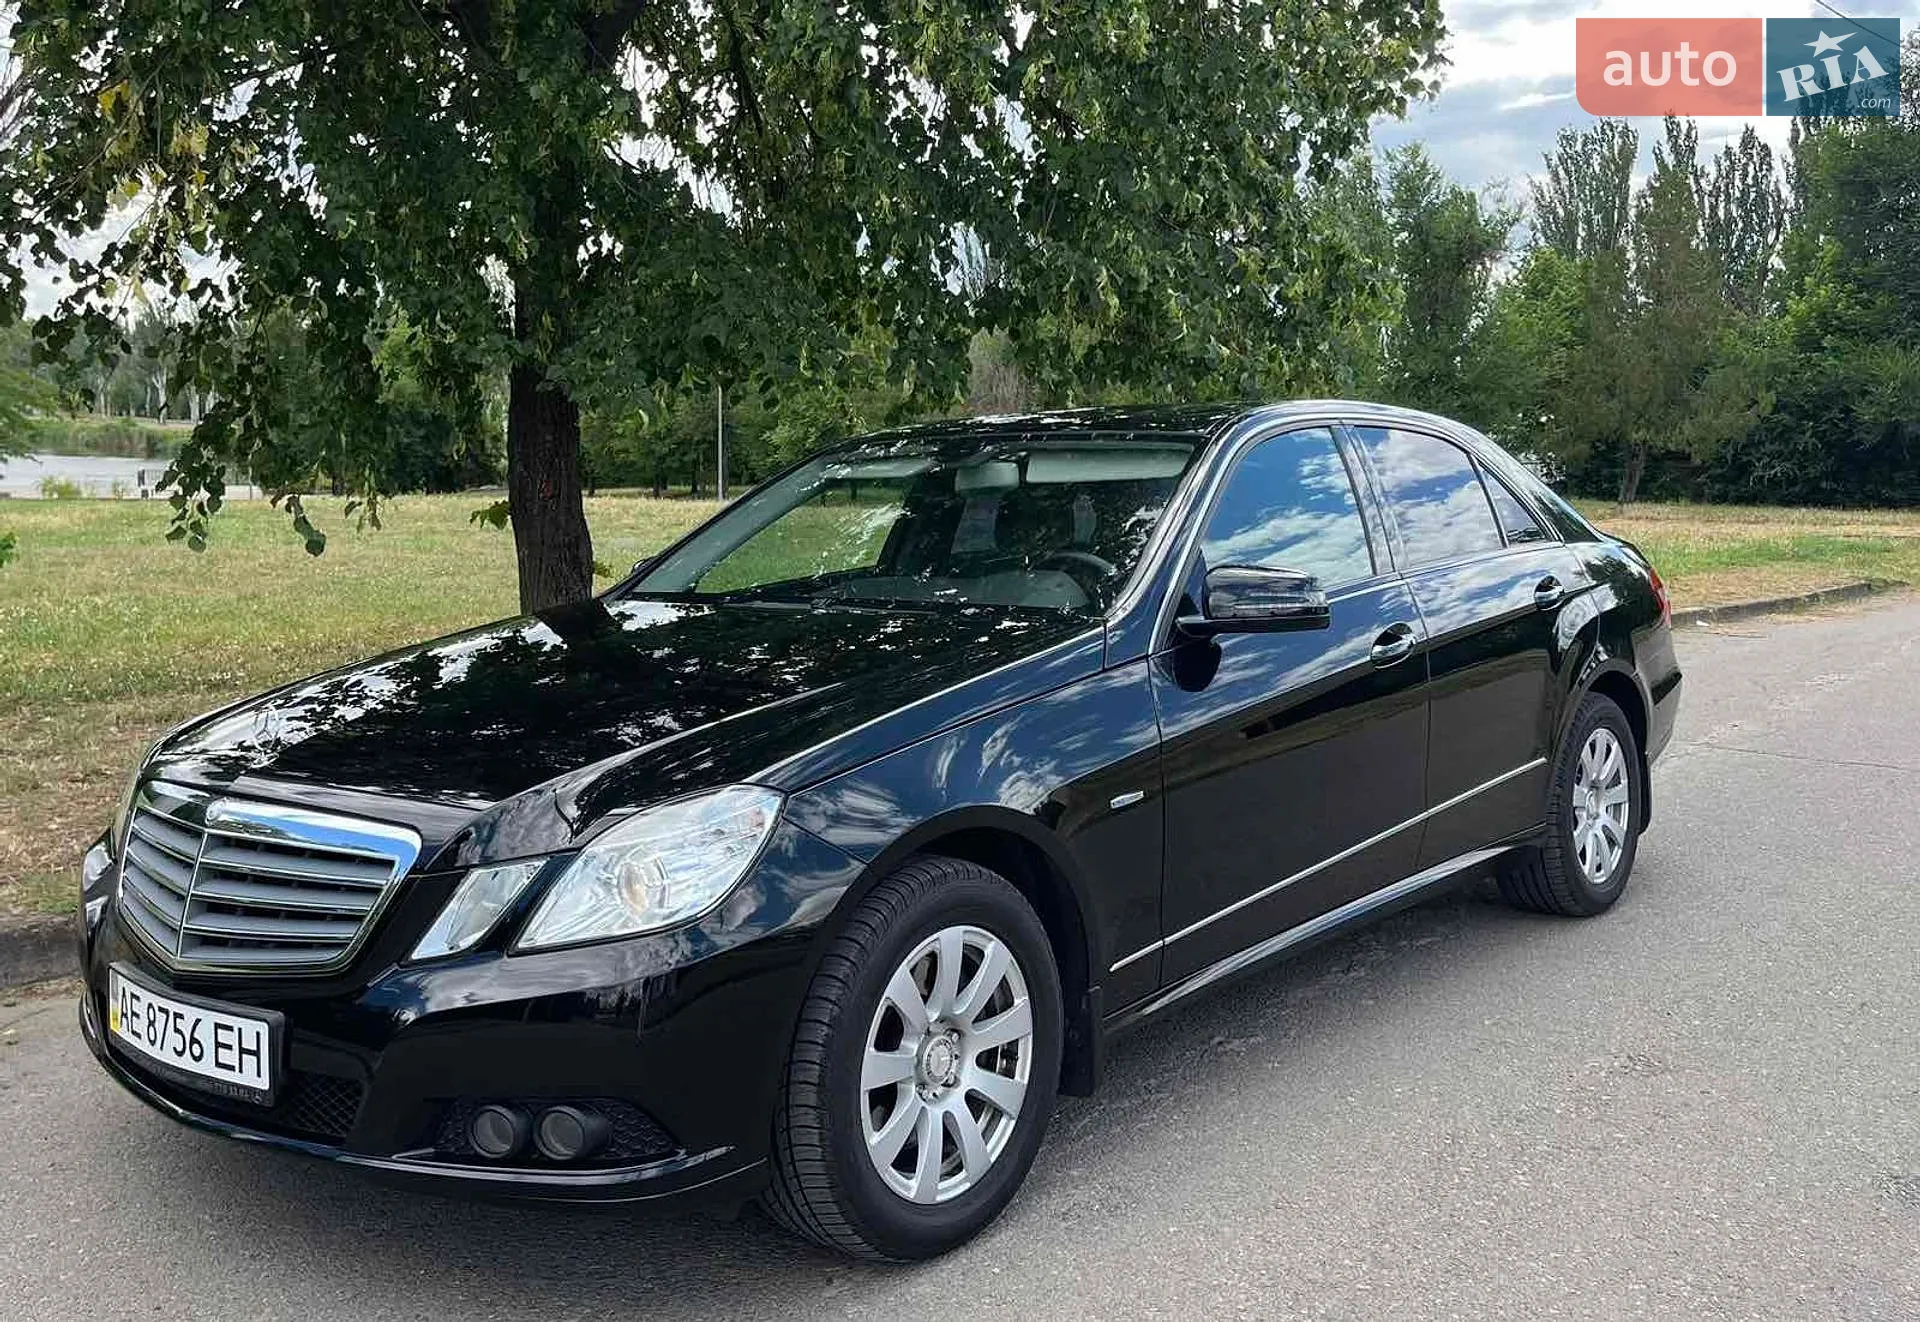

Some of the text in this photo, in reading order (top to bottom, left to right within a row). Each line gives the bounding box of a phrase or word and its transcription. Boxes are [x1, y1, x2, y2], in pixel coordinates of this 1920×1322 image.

[120, 986, 262, 1079] AE 8756 EH
